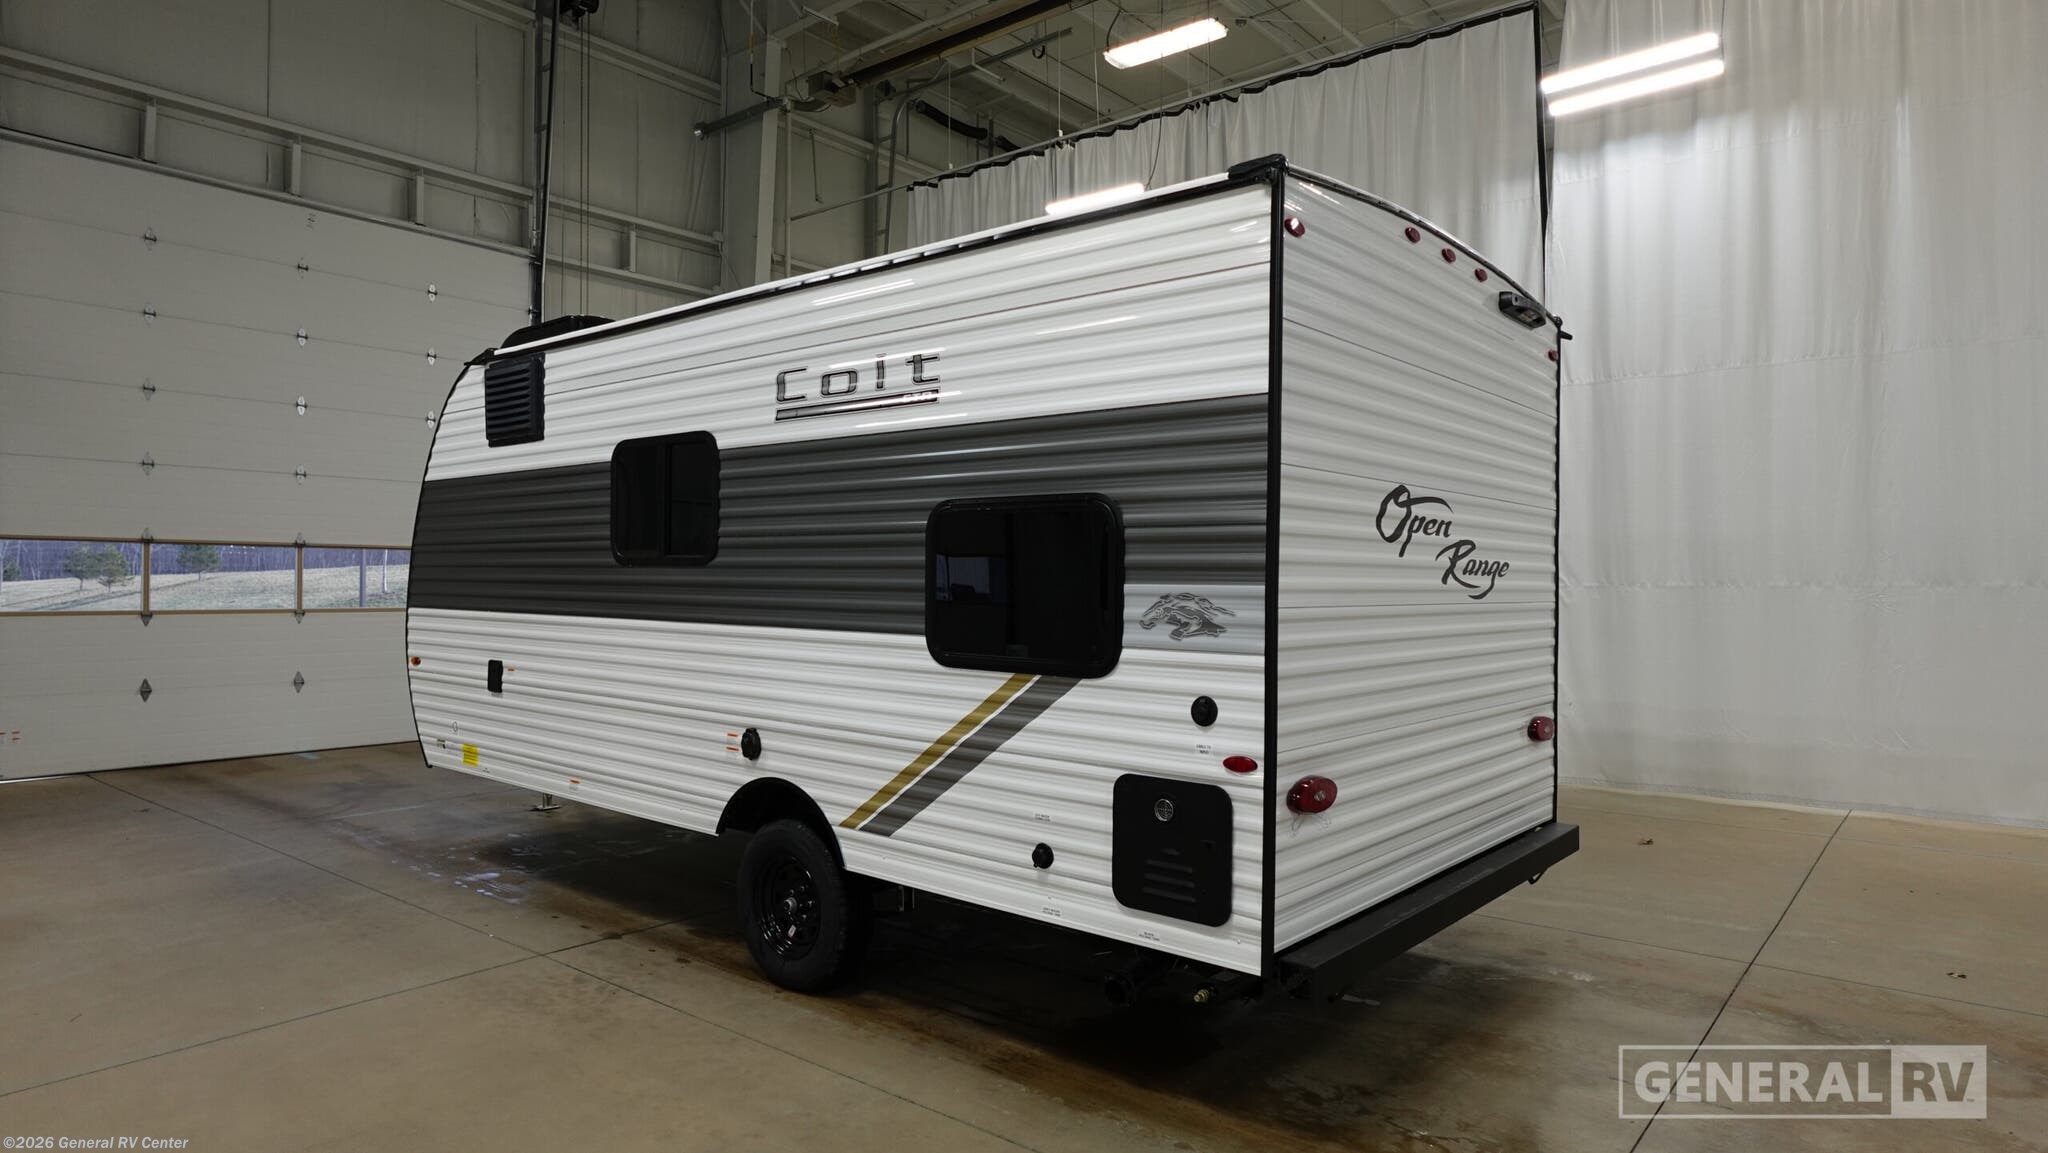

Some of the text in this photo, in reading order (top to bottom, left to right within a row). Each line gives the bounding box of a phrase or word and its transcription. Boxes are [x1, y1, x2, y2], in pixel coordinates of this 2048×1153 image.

[775, 353, 940, 403] Colt
[1375, 484, 1454, 558] Open
[1435, 539, 1510, 600] Range
